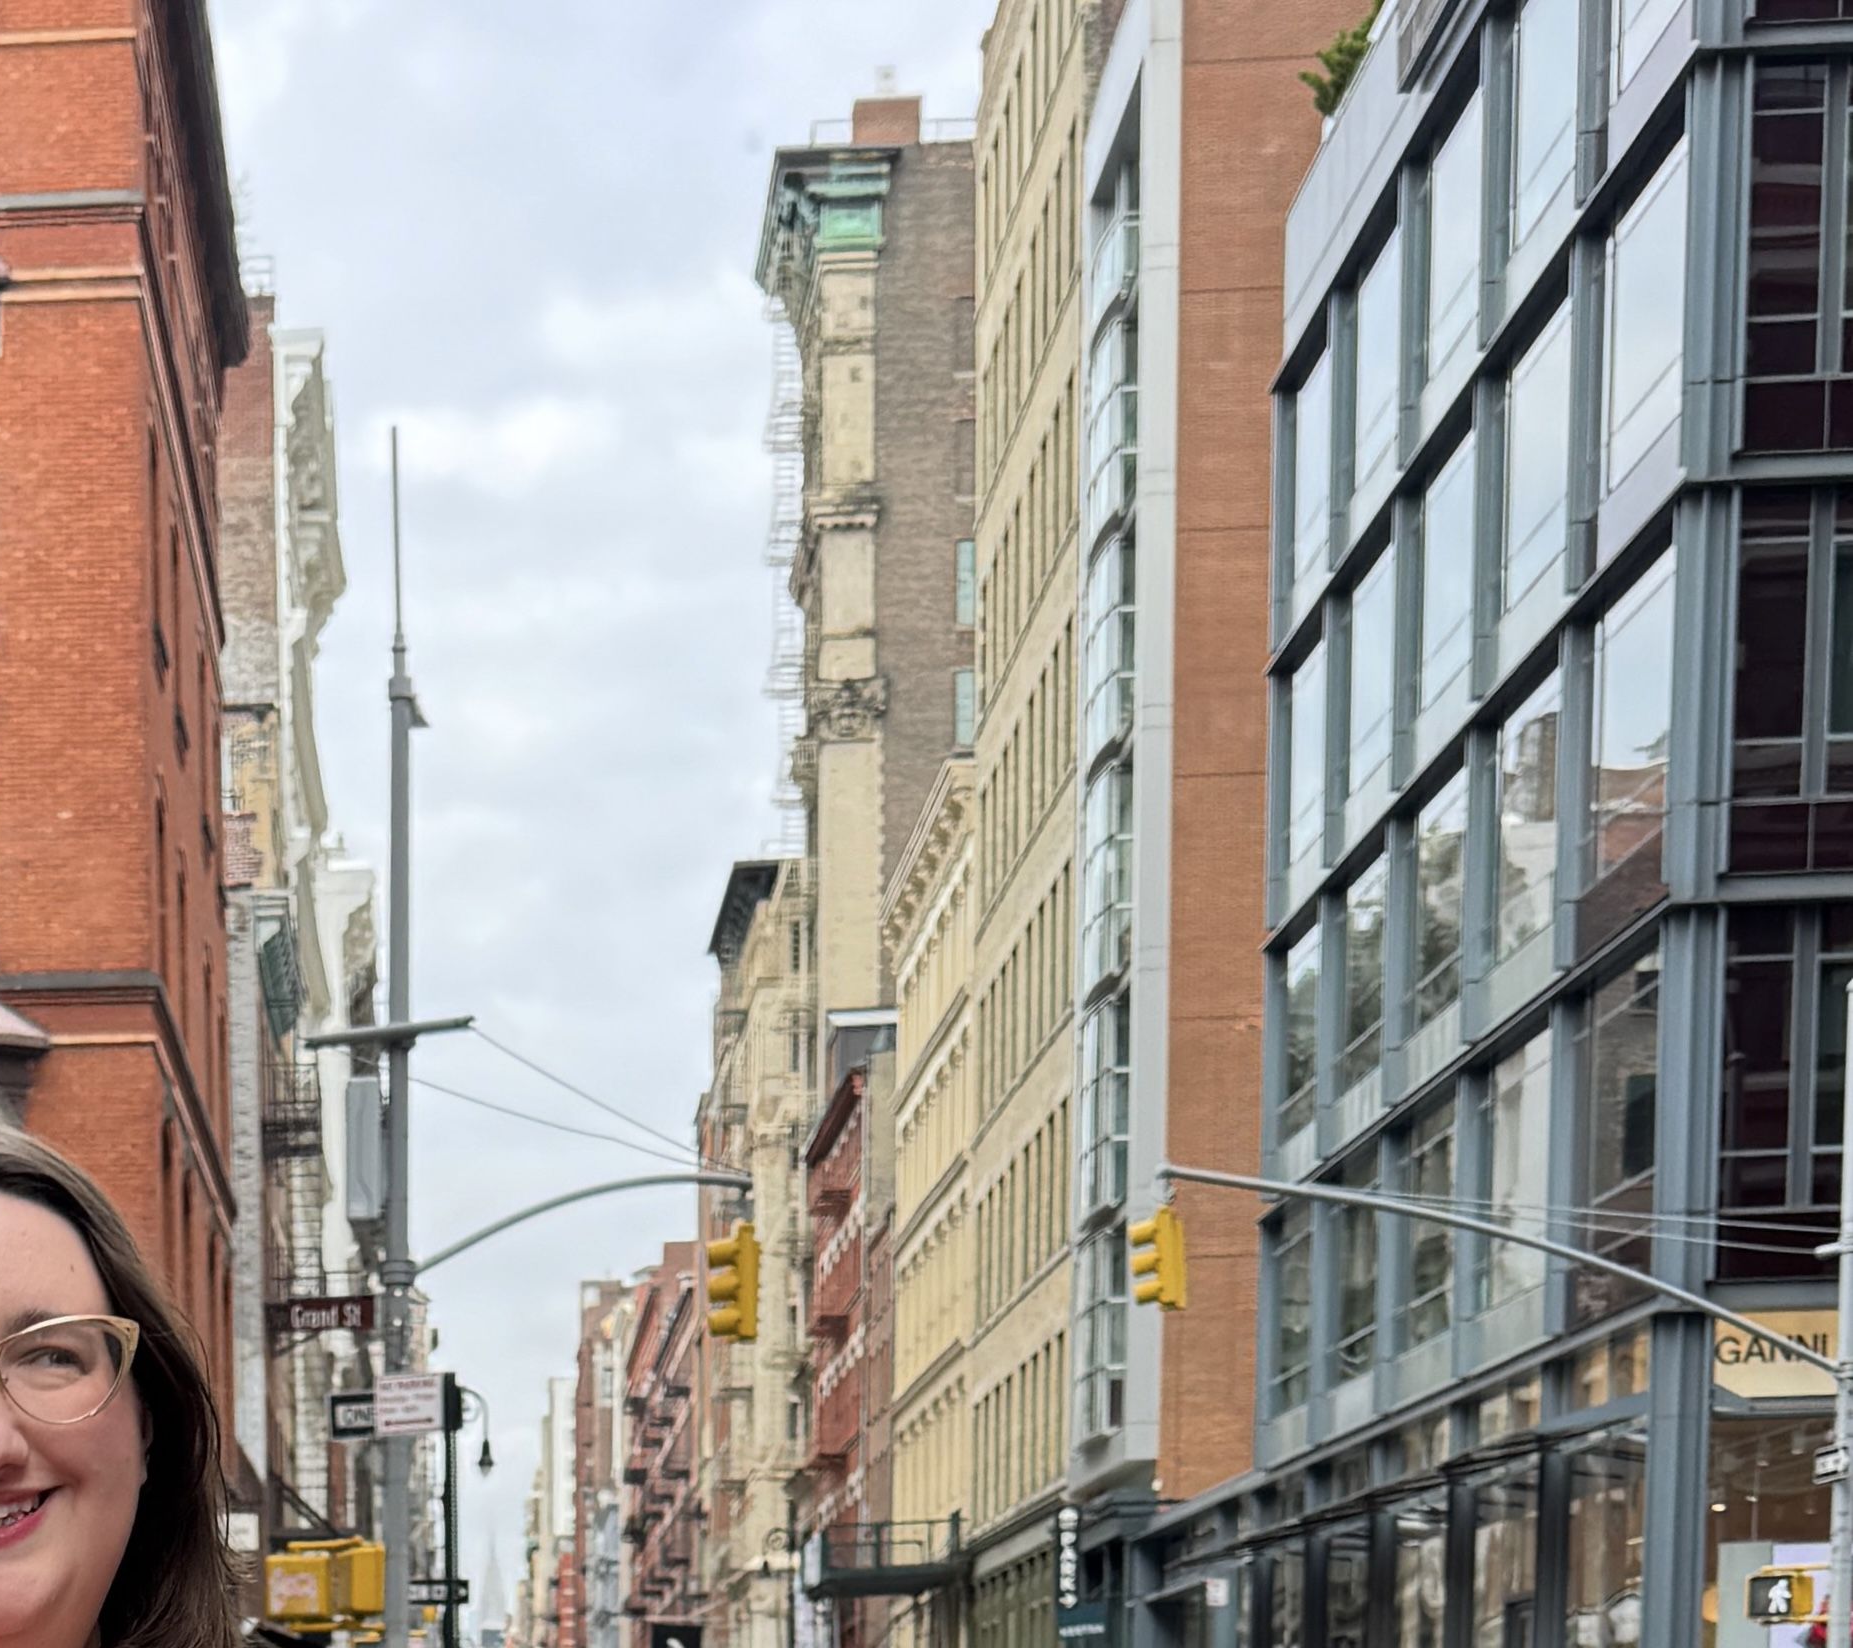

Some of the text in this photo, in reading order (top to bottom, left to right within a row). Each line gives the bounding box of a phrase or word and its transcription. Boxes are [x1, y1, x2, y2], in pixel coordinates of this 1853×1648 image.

[290, 1302, 362, 1329] Grand St
[1059, 1530, 1077, 1592] PARK
